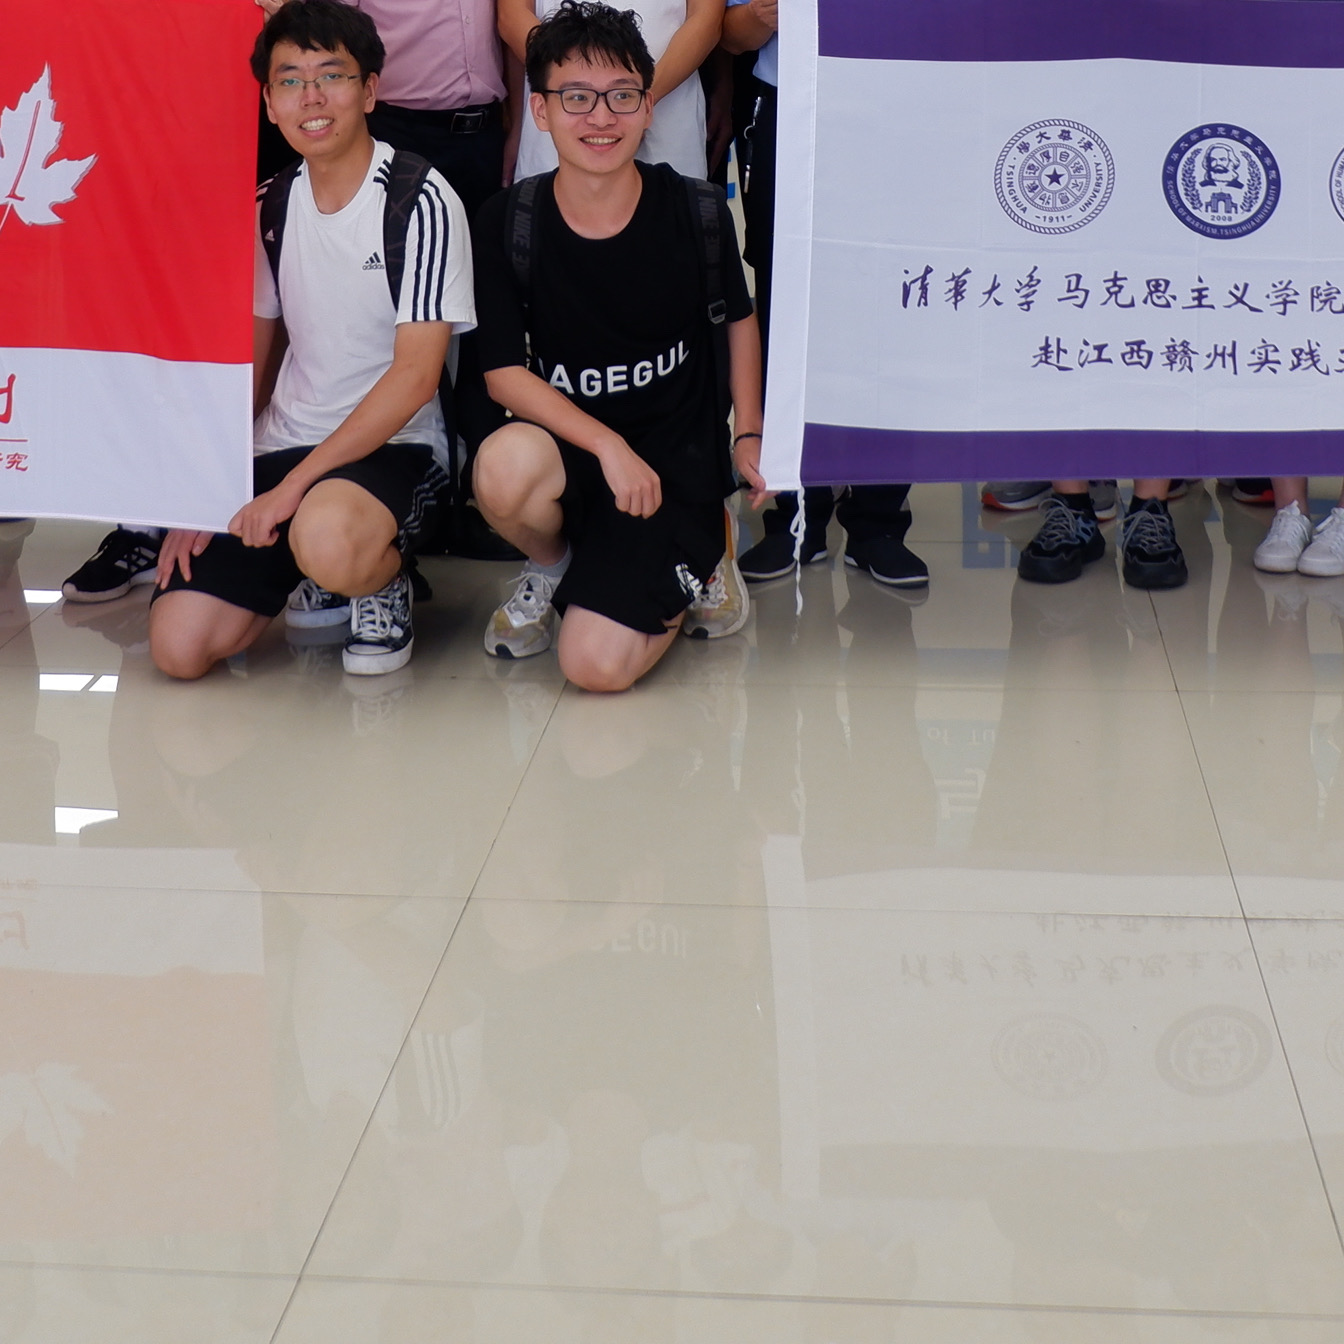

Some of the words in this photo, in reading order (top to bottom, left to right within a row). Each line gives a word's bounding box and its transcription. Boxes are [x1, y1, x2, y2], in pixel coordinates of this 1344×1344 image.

[1006, 164, 1028, 214] TSINGHUA
[1078, 161, 1103, 213] UNIVERSITY
[1210, 214, 1233, 222] 2008
[362, 263, 385, 271] adidas
